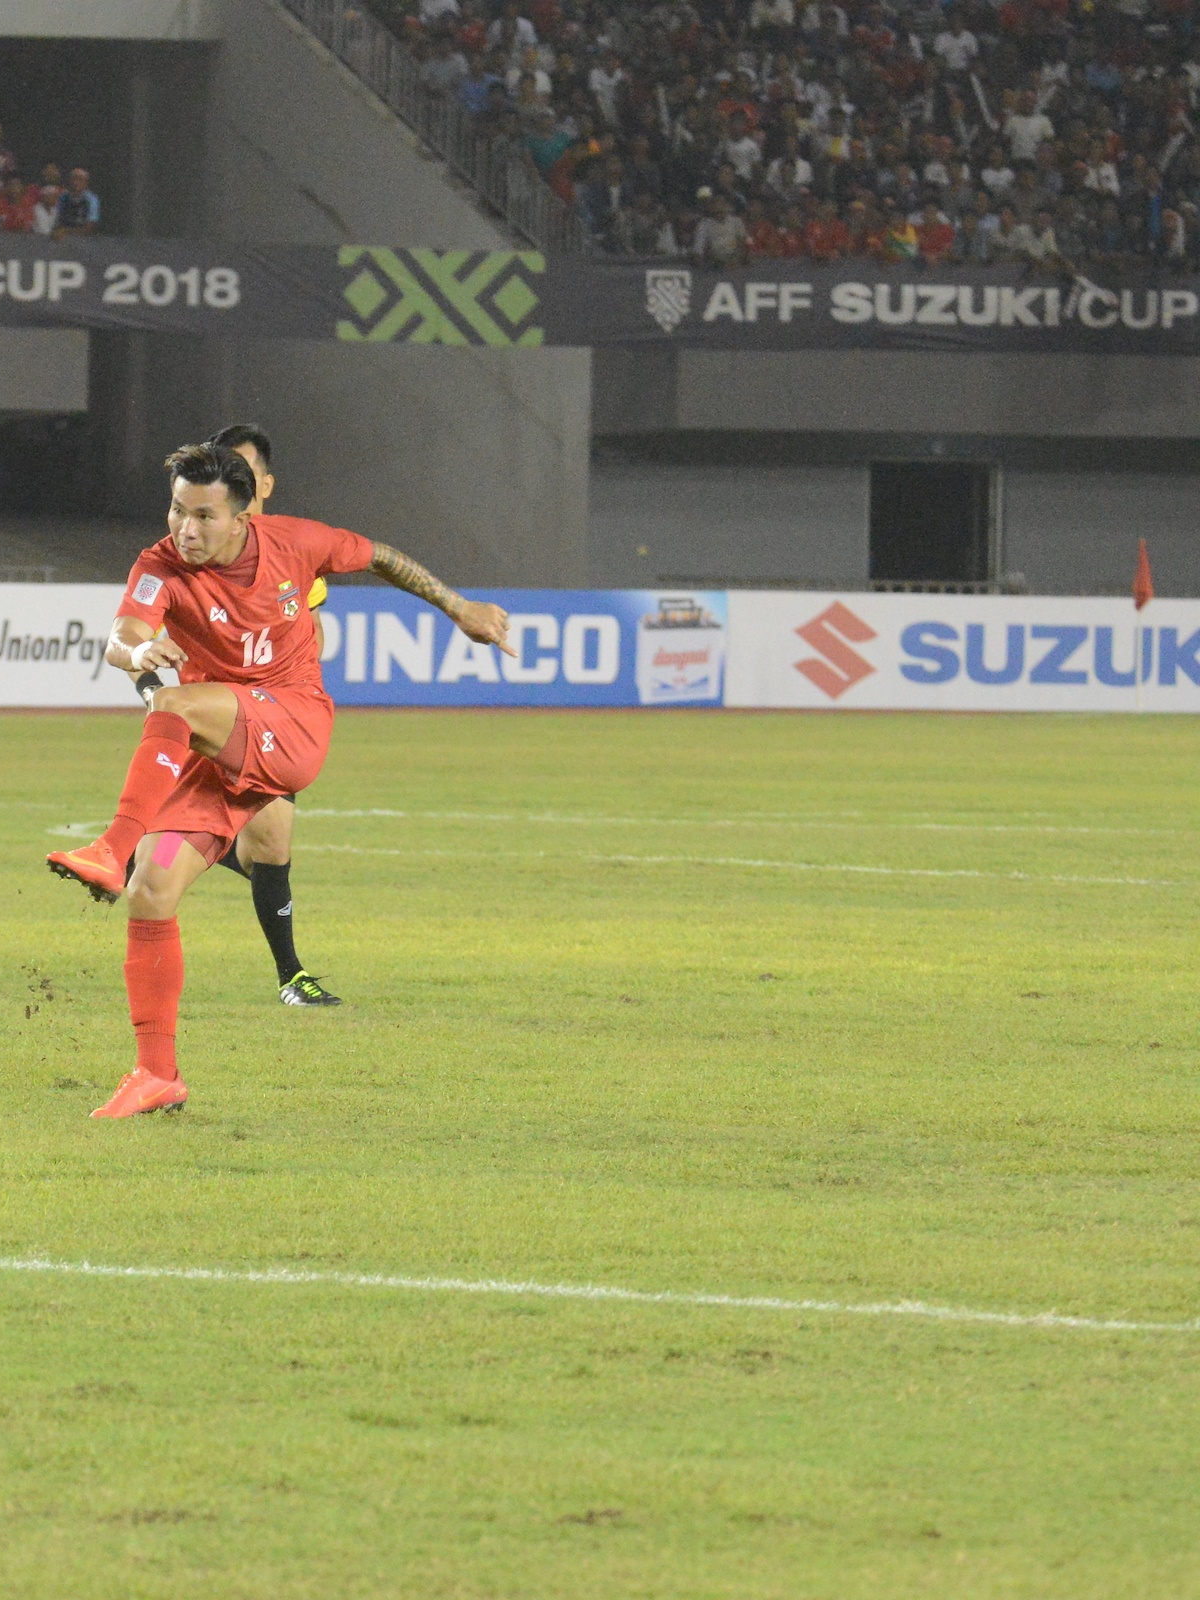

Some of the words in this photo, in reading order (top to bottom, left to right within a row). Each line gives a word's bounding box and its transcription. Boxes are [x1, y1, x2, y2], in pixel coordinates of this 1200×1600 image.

[103, 264, 241, 308] 2018
[703, 281, 812, 323] AFF
[829, 282, 1060, 328] SUZUKI
[1079, 288, 1198, 329] CUP
[240, 626, 274, 668] 16
